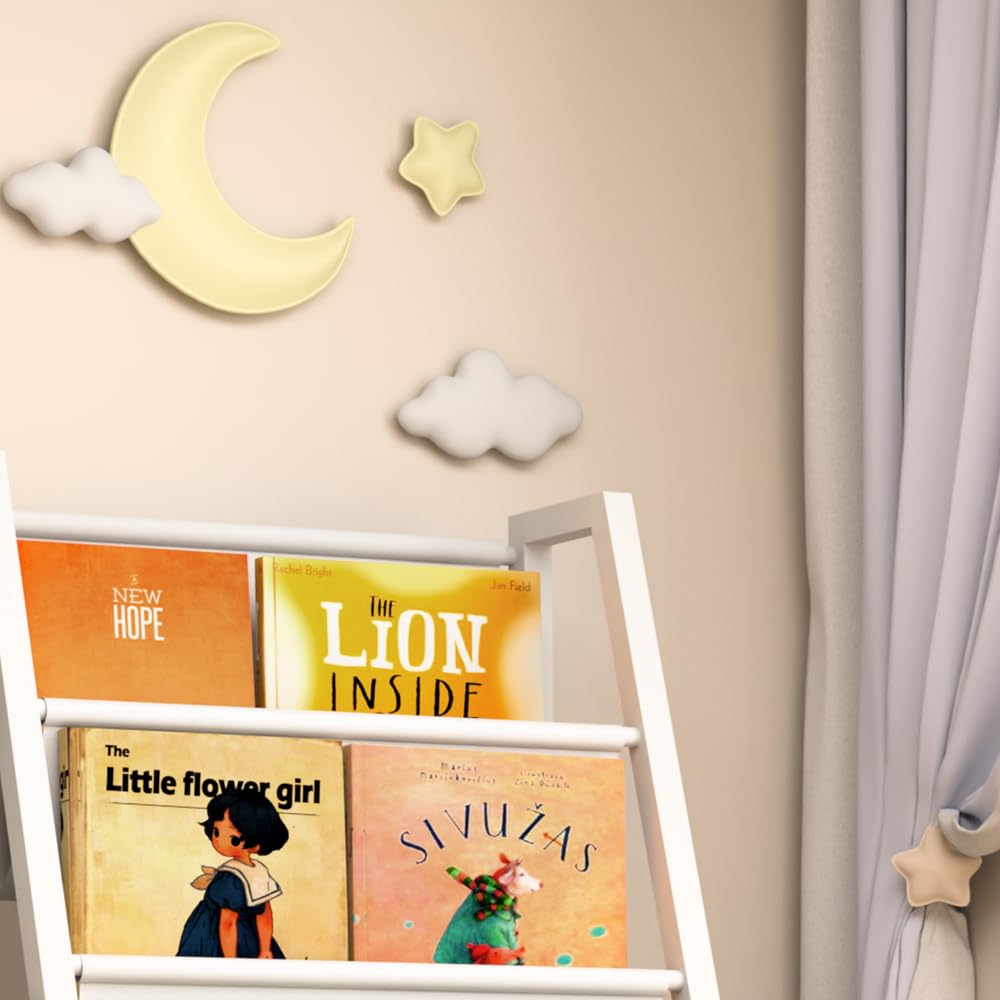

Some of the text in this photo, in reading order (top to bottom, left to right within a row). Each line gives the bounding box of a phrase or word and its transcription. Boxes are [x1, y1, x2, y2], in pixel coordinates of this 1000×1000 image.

[112, 587, 163, 605] NEW
[369, 595, 397, 618] THE
[113, 604, 165, 641] HOPE
[331, 672, 482, 719] INSIDE
[105, 744, 130, 758] The
[106, 766, 321, 810] Little flower girl
[400, 801, 598, 873] SIVUŽAS
